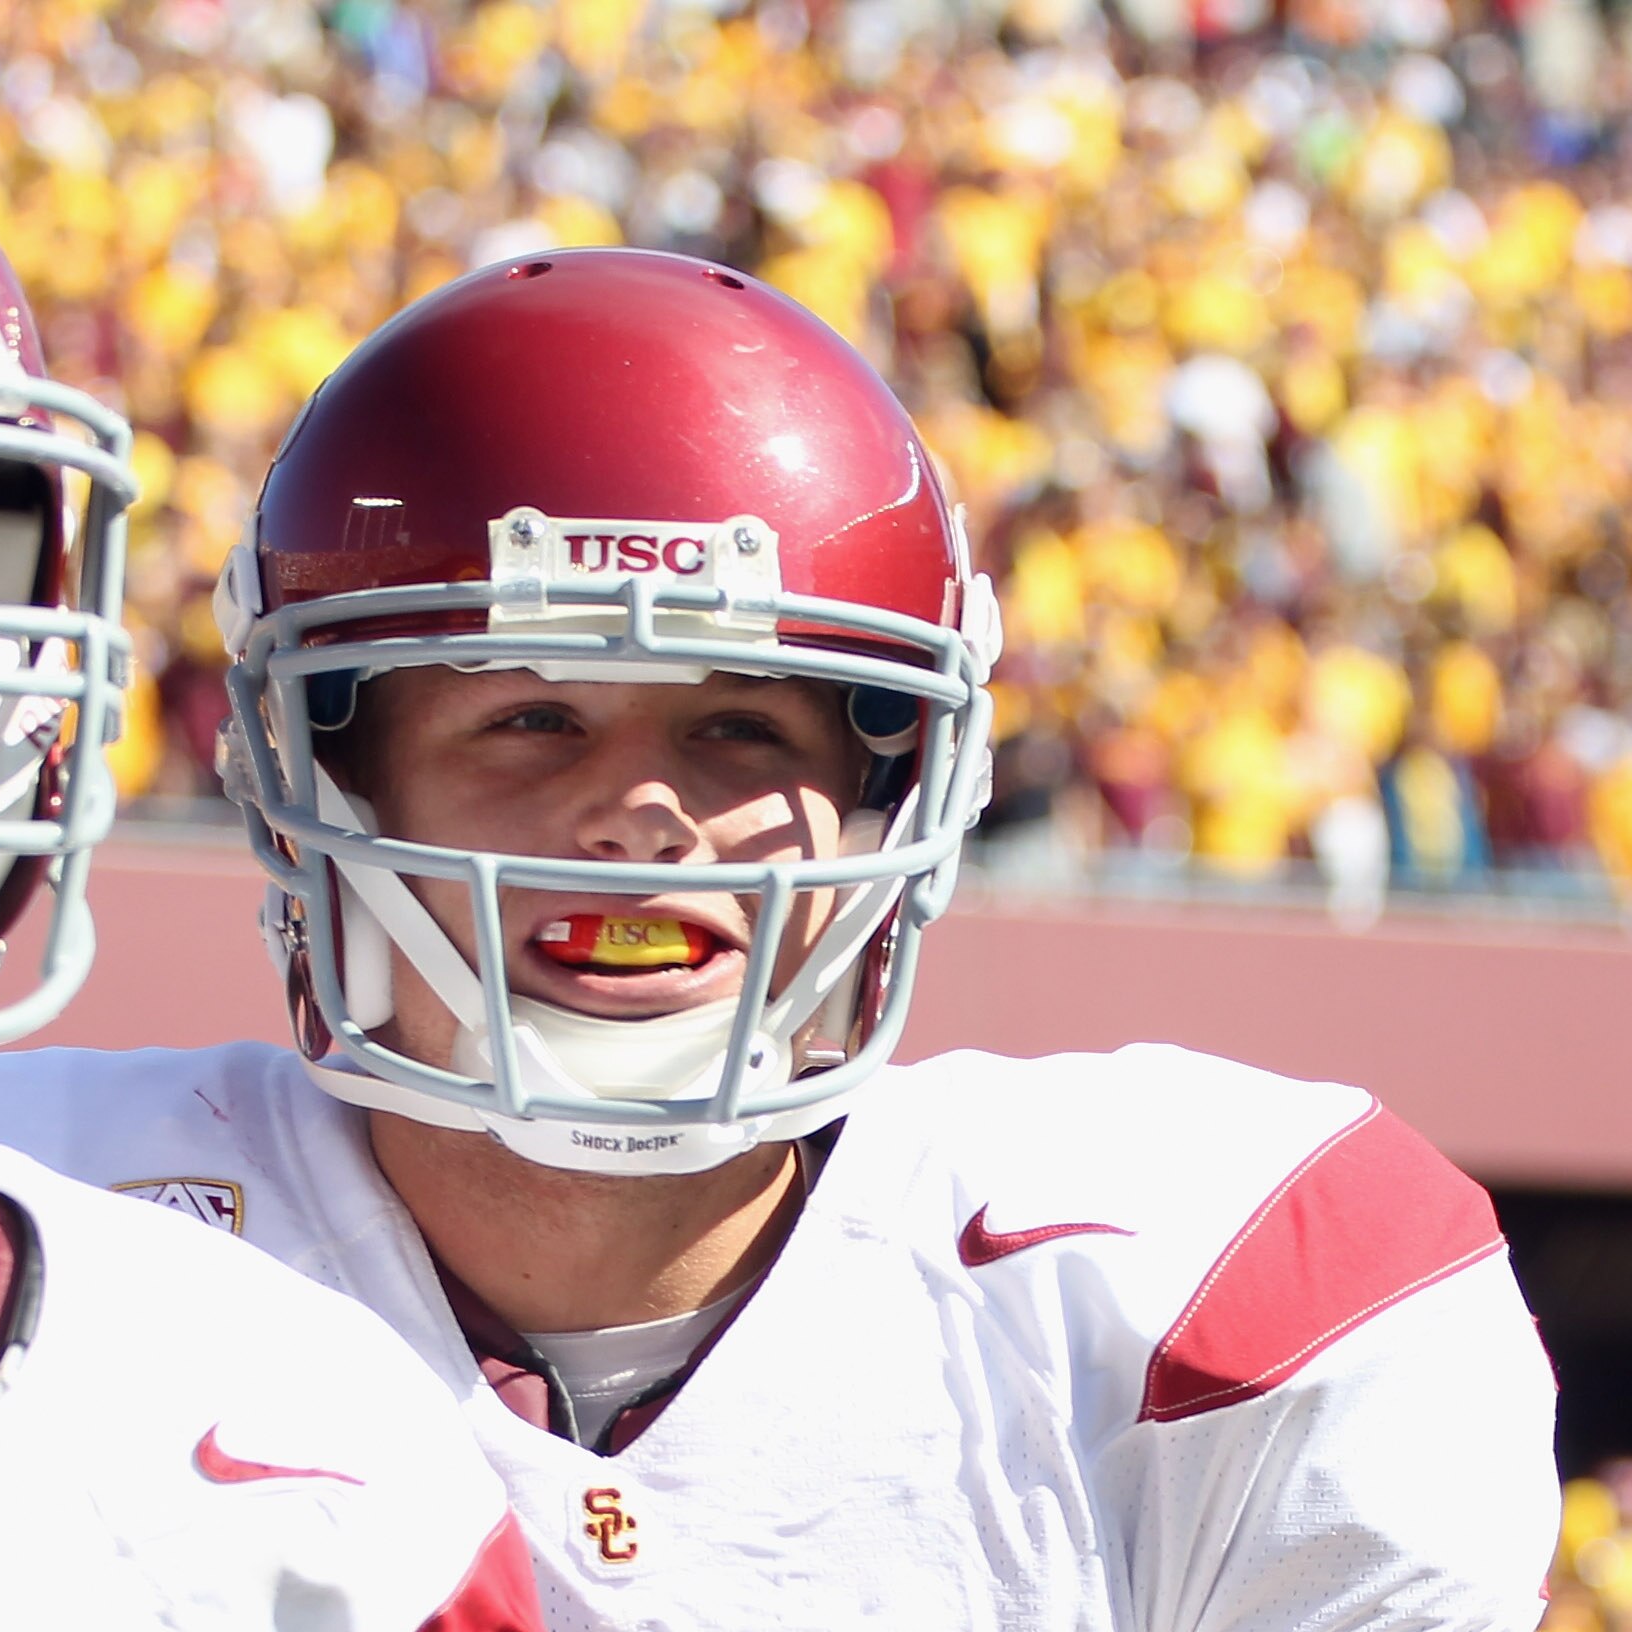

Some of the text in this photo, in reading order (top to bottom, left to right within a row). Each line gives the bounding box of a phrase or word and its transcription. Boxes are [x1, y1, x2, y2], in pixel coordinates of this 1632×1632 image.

[562, 535, 706, 575] USC
[606, 923, 662, 947] USC
[571, 1130, 622, 1153] SHOCK
[582, 1486, 637, 1564] SC
